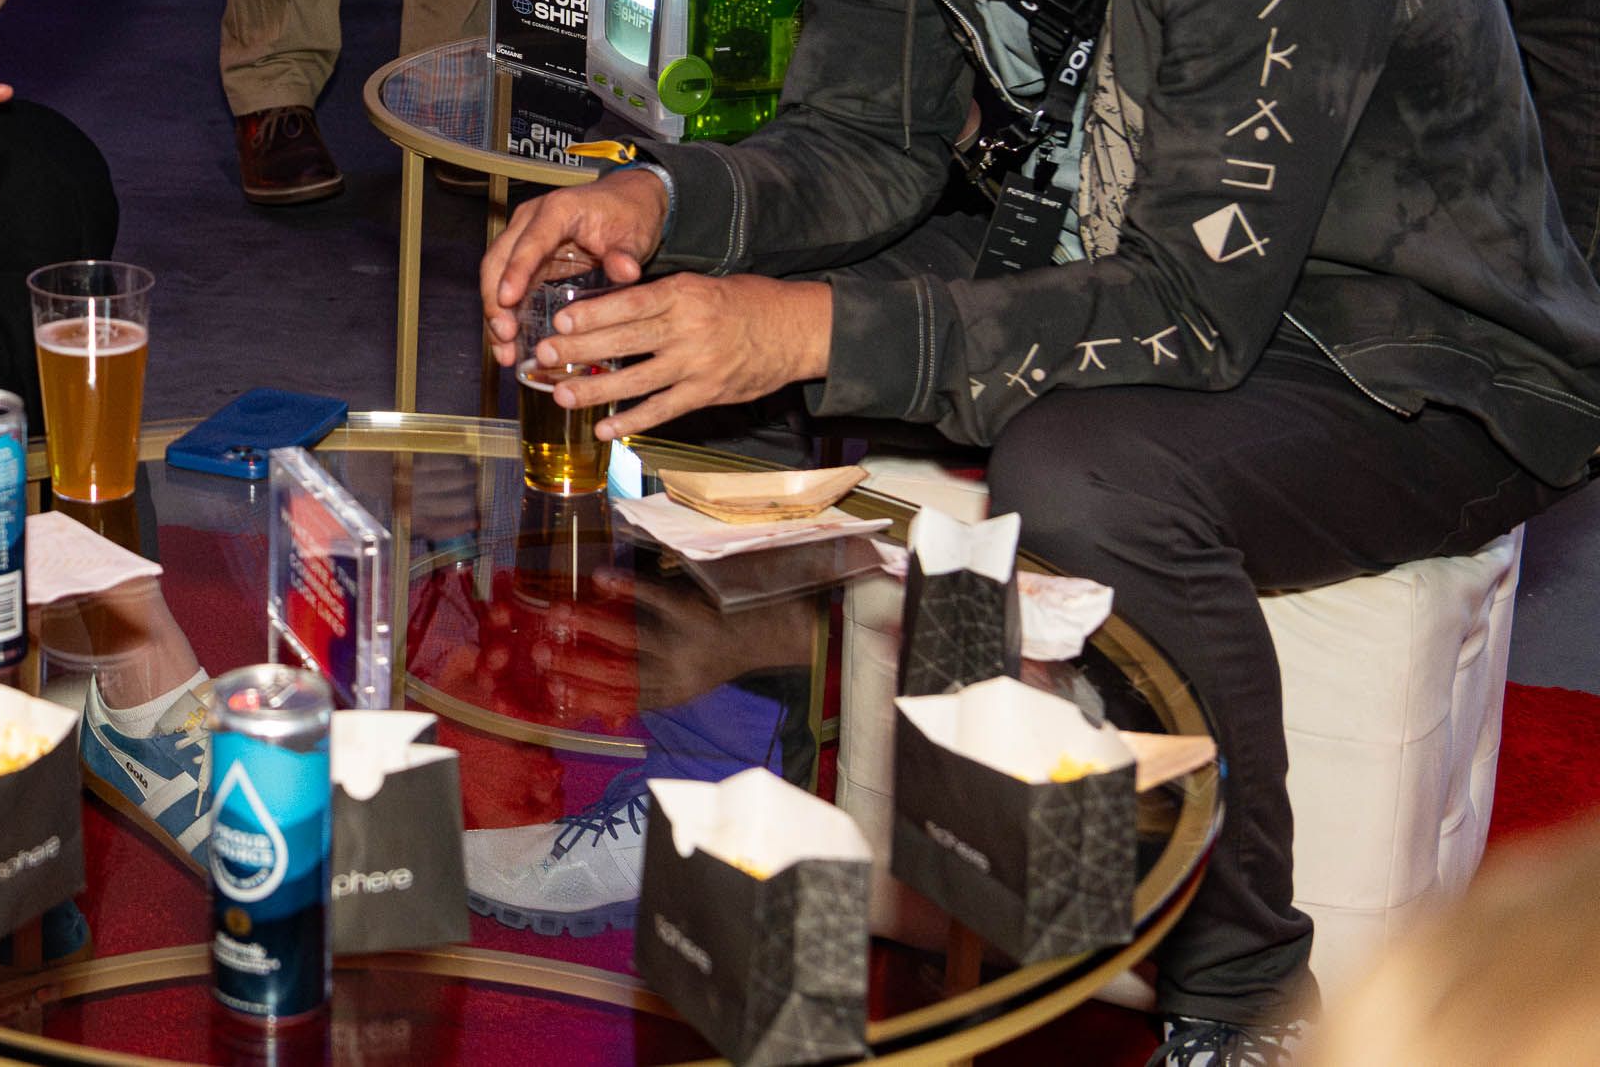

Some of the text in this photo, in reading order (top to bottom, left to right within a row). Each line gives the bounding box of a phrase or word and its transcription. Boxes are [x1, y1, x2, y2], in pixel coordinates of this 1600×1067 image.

[534, 2, 588, 28] SHIF
[125, 761, 149, 790] Gola
[330, 867, 414, 902] phere
